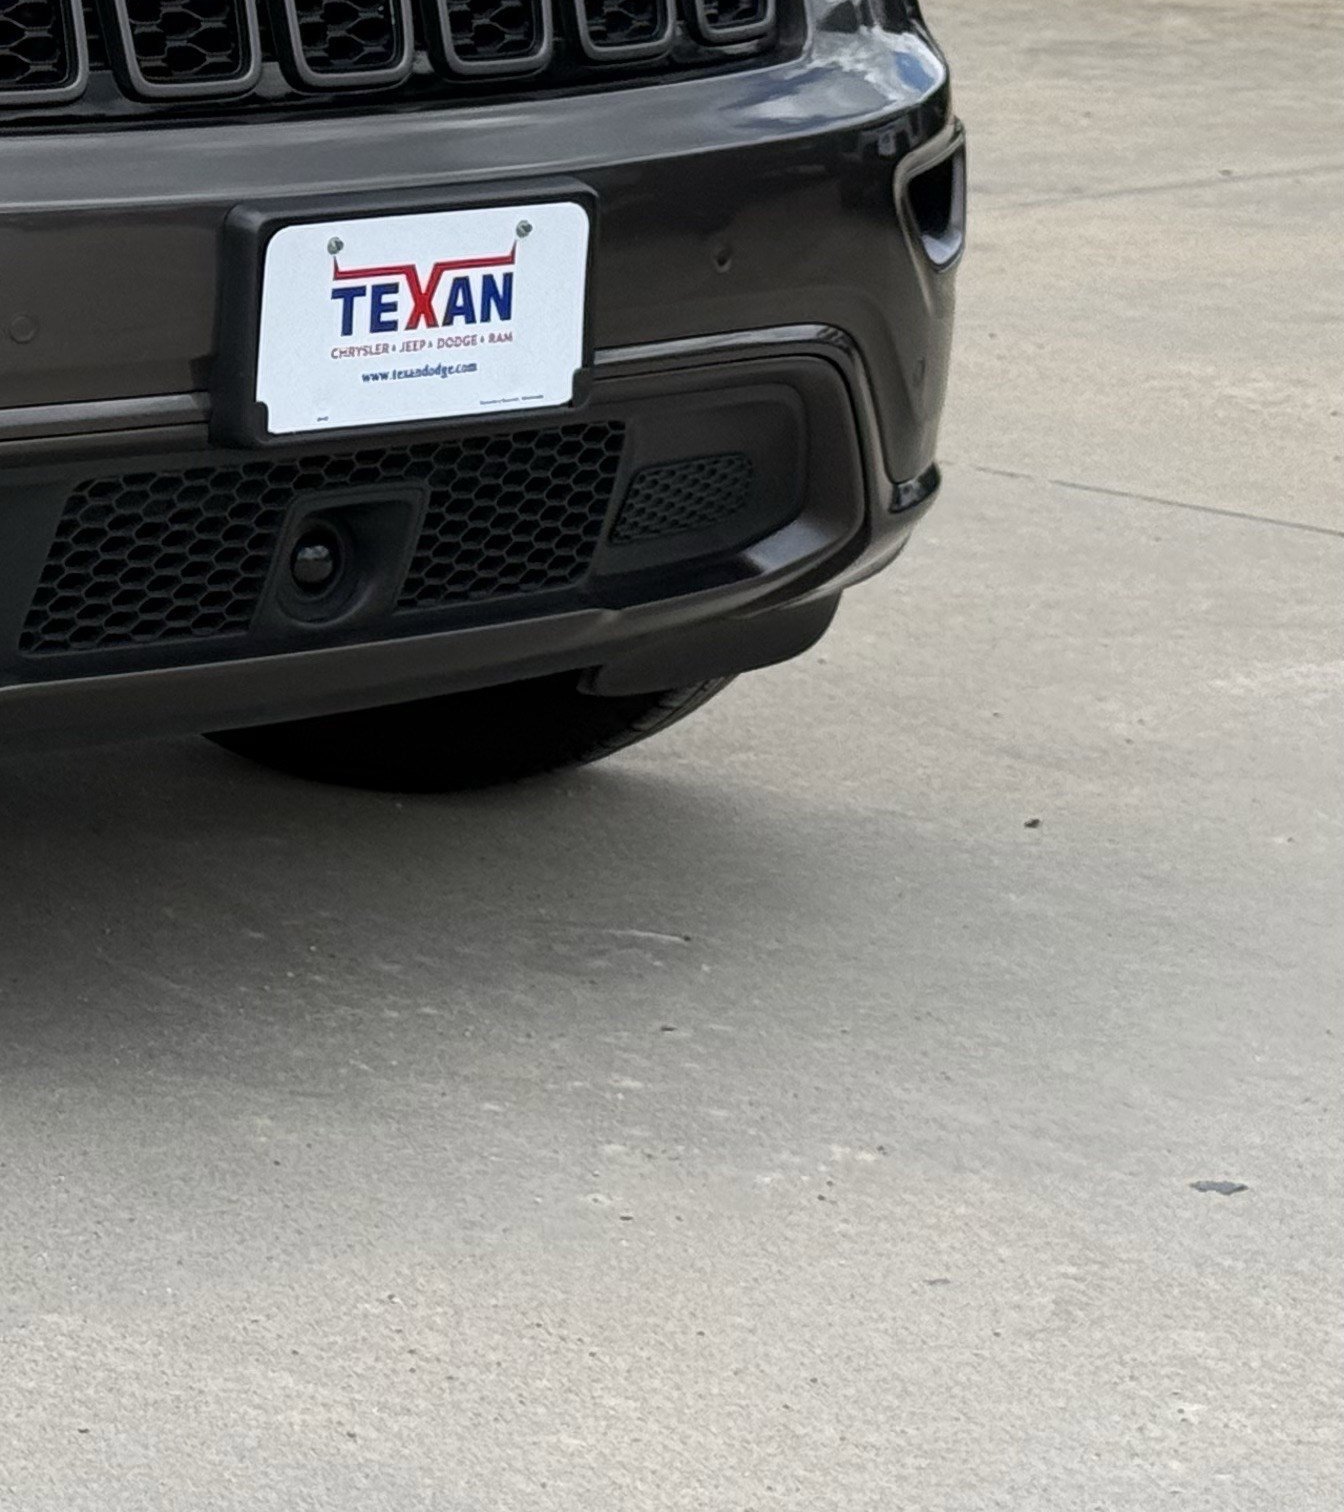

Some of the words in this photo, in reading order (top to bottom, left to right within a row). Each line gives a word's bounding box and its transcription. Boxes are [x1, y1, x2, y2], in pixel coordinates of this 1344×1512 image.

[330, 263, 516, 337] TEXAN
[330, 343, 390, 360] CHRYSLER
[399, 339, 427, 353] JEEP
[436, 334, 478, 350] DODGE
[488, 331, 514, 344] RAM
